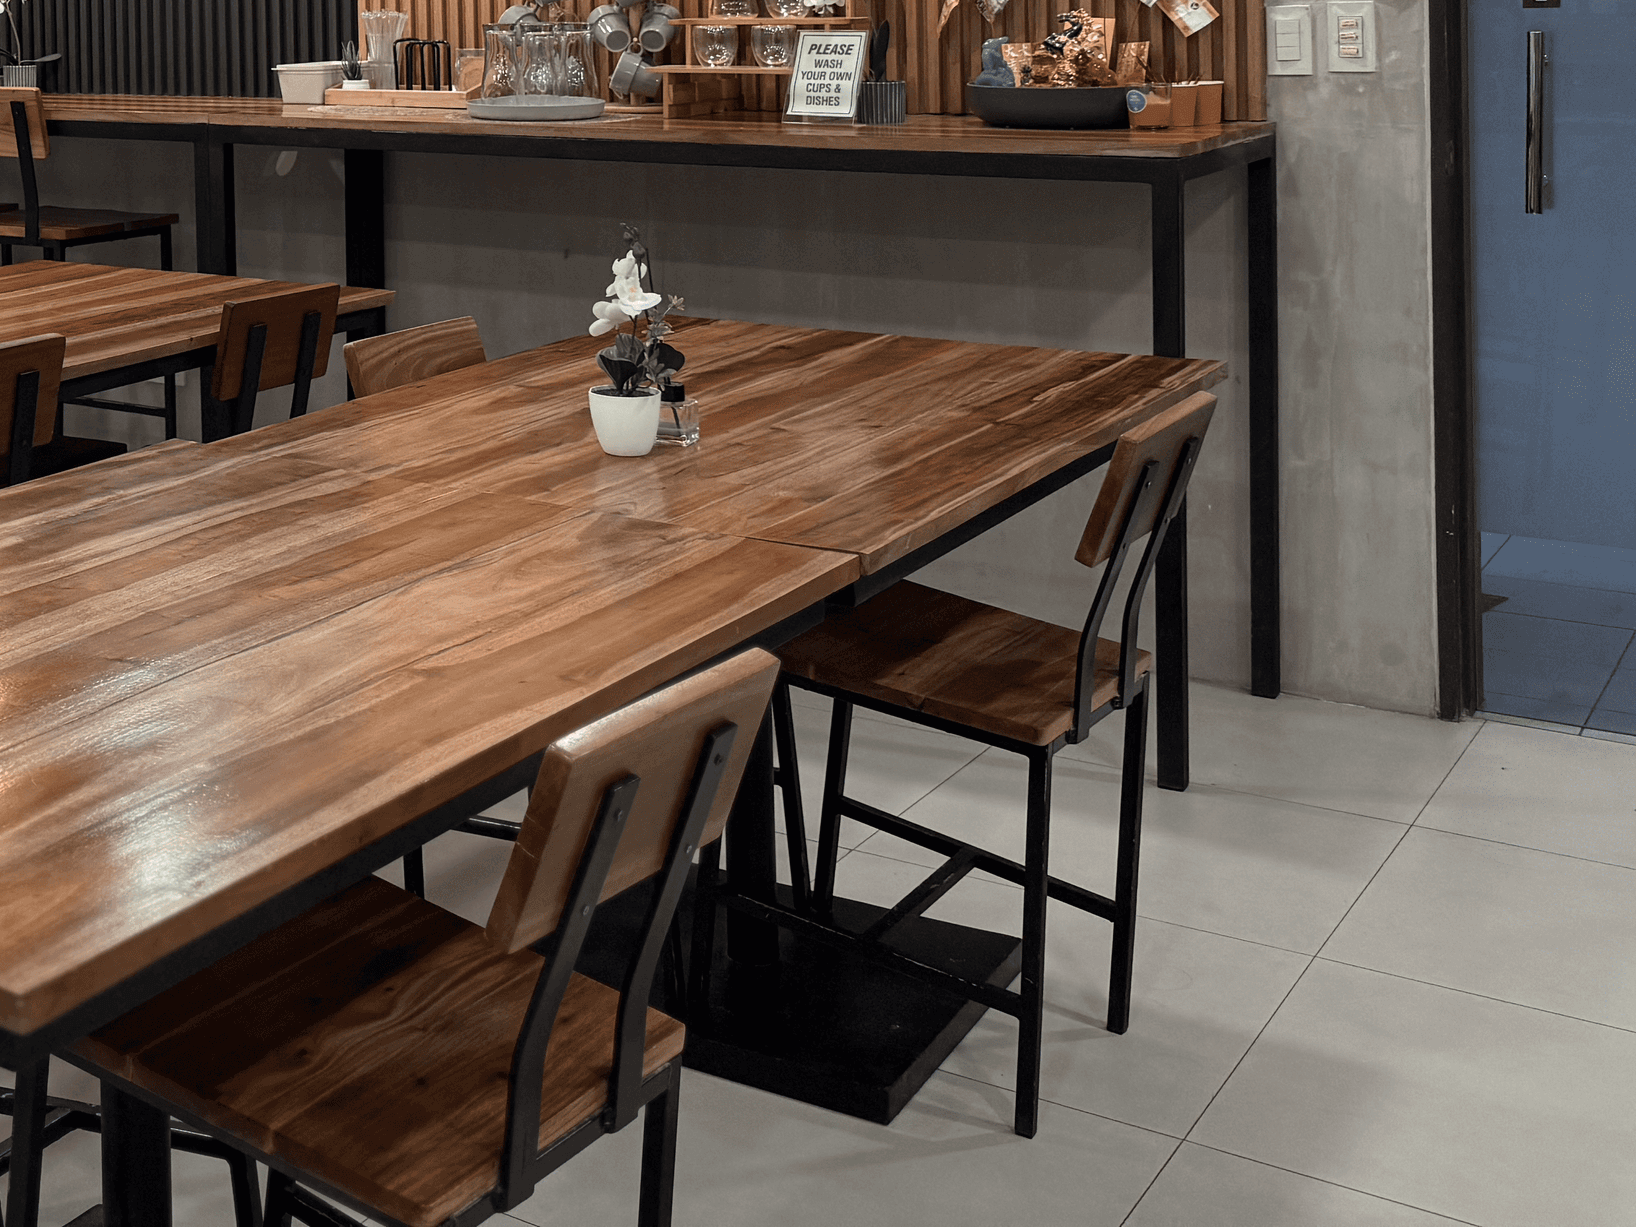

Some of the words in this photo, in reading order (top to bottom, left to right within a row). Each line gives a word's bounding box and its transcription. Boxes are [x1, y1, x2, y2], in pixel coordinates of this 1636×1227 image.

[808, 44, 854, 55] PLEASE
[814, 59, 843, 69] WASH
[801, 71, 826, 81] YOUR
[828, 71, 853, 81] OWN
[806, 83, 831, 93] CUPS
[834, 83, 842, 93] &
[806, 96, 840, 106] DISHES
